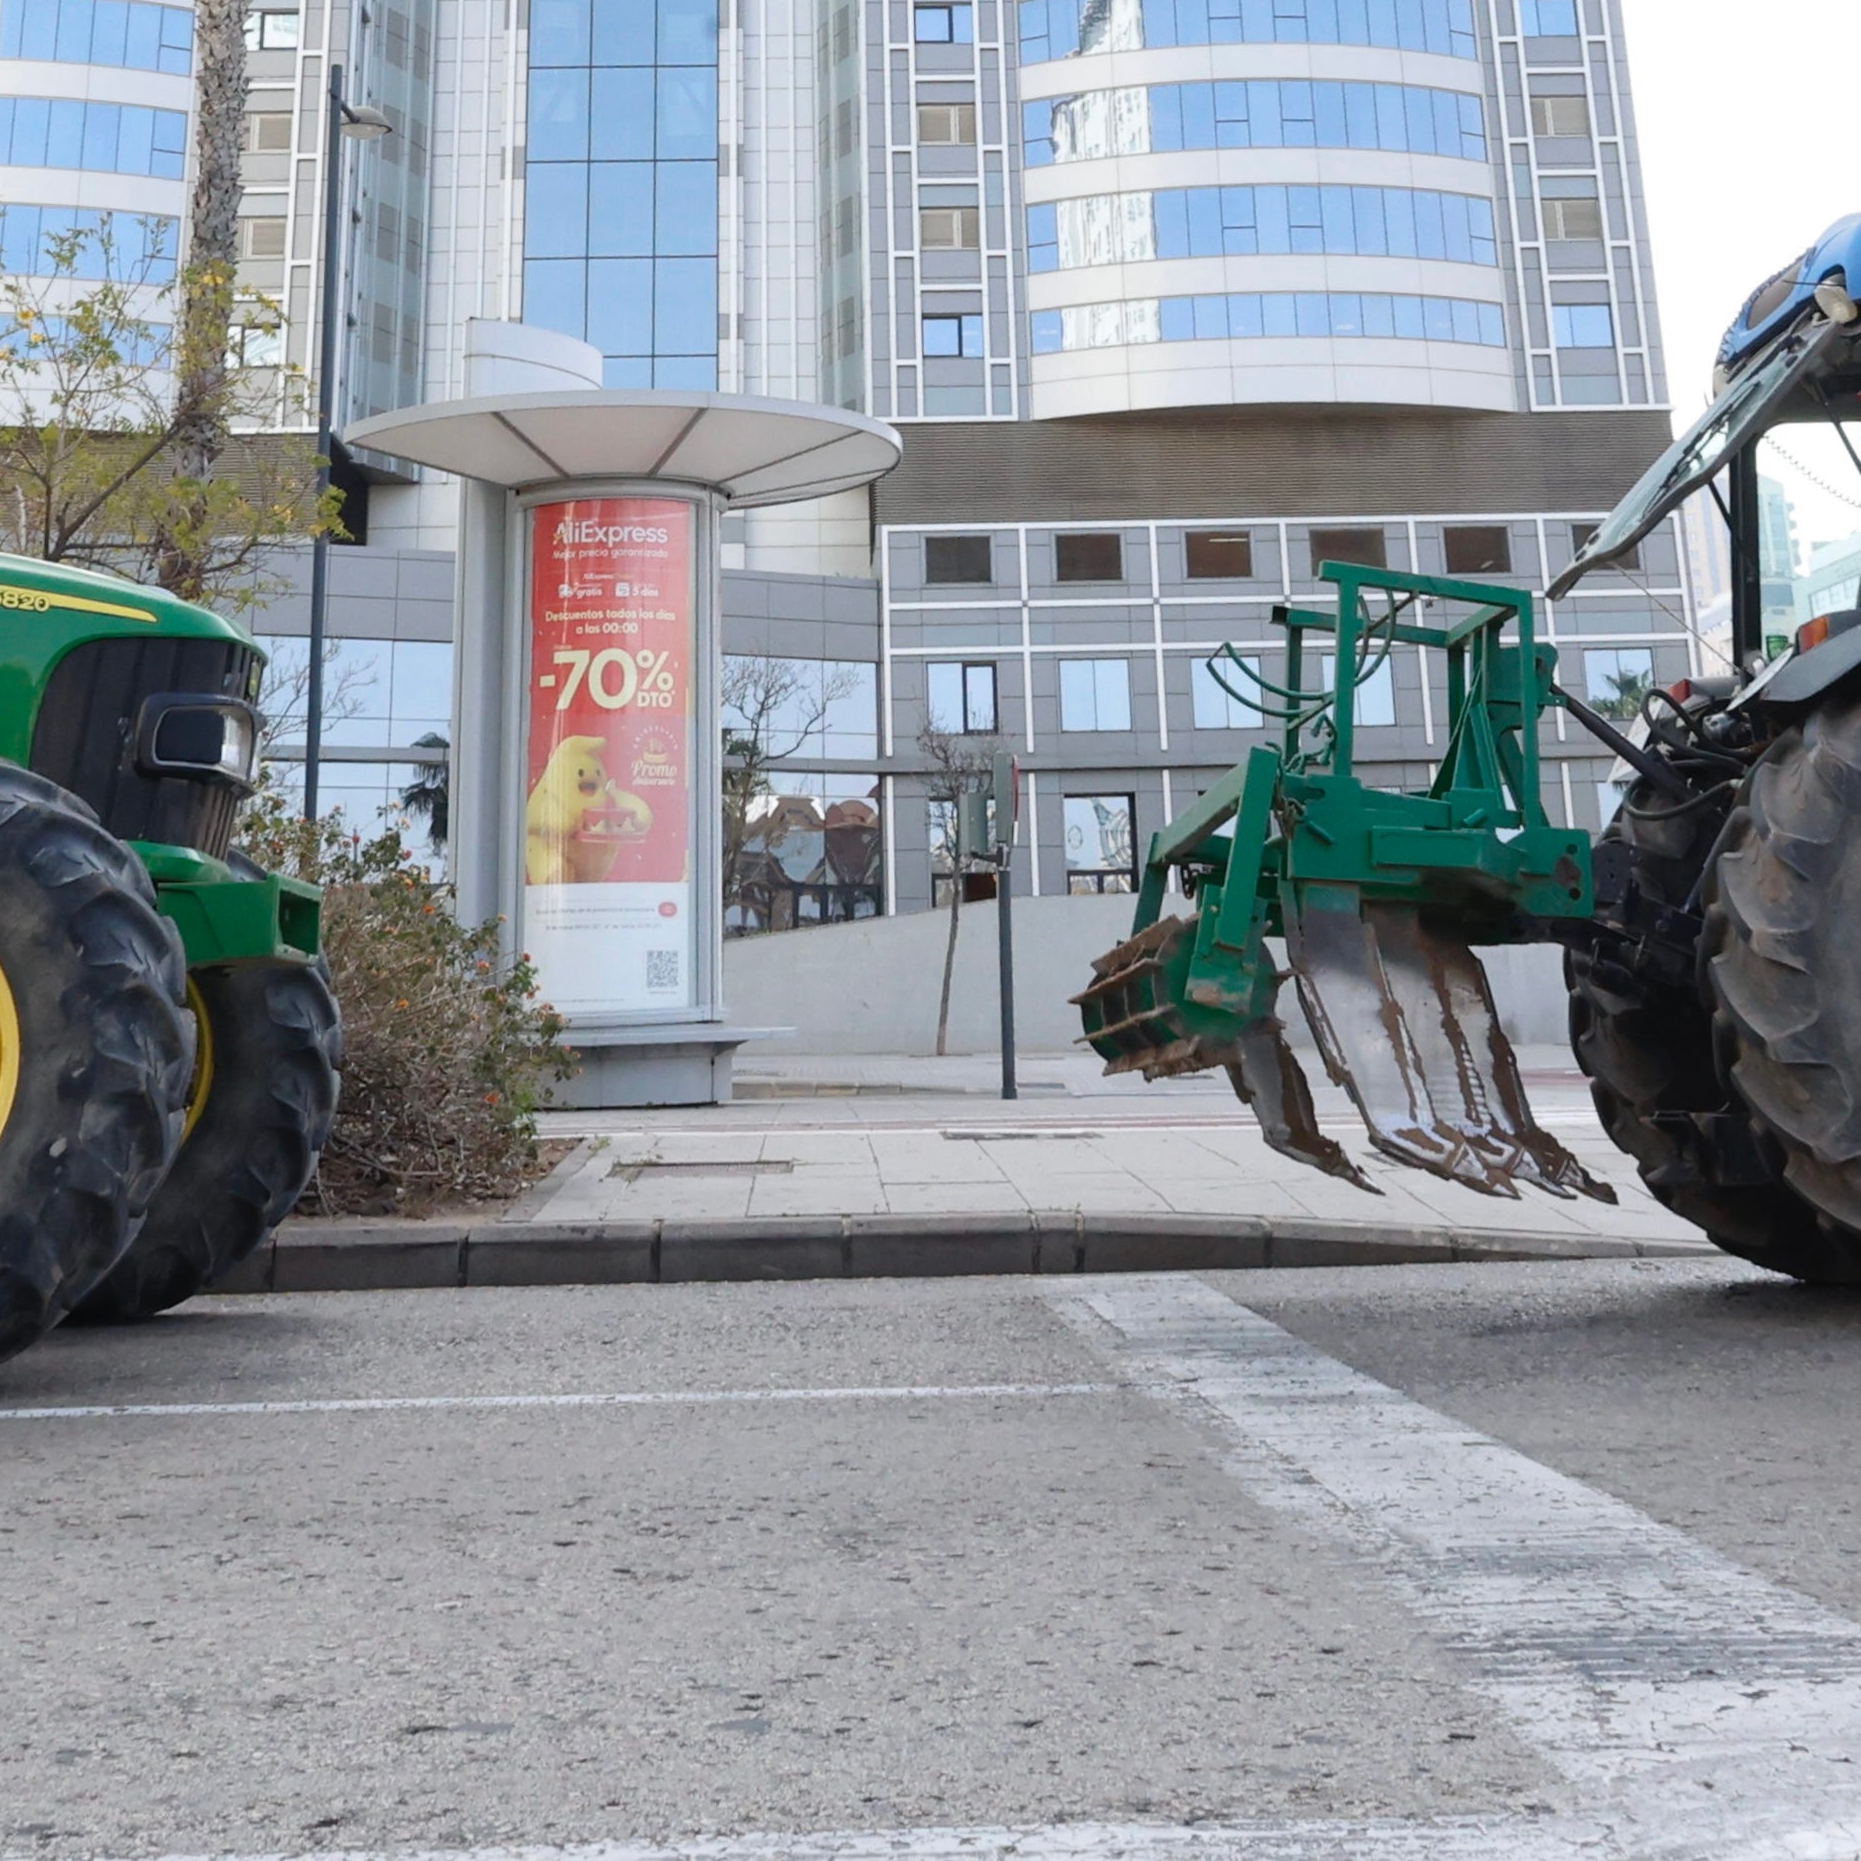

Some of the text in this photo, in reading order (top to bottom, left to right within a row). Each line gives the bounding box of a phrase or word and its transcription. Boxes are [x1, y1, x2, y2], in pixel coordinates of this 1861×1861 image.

[553, 520, 668, 548] AliExpress
[579, 549, 609, 560] precio
[611, 548, 668, 559] garantizado
[576, 586, 603, 599] gratis
[546, 611, 604, 622] Descuentos
[606, 609, 637, 620] todos
[639, 608, 654, 619] los
[576, 622, 638, 635] a las 00:00
[540, 648, 674, 710] -70%
[631, 757, 678, 777] Promo
